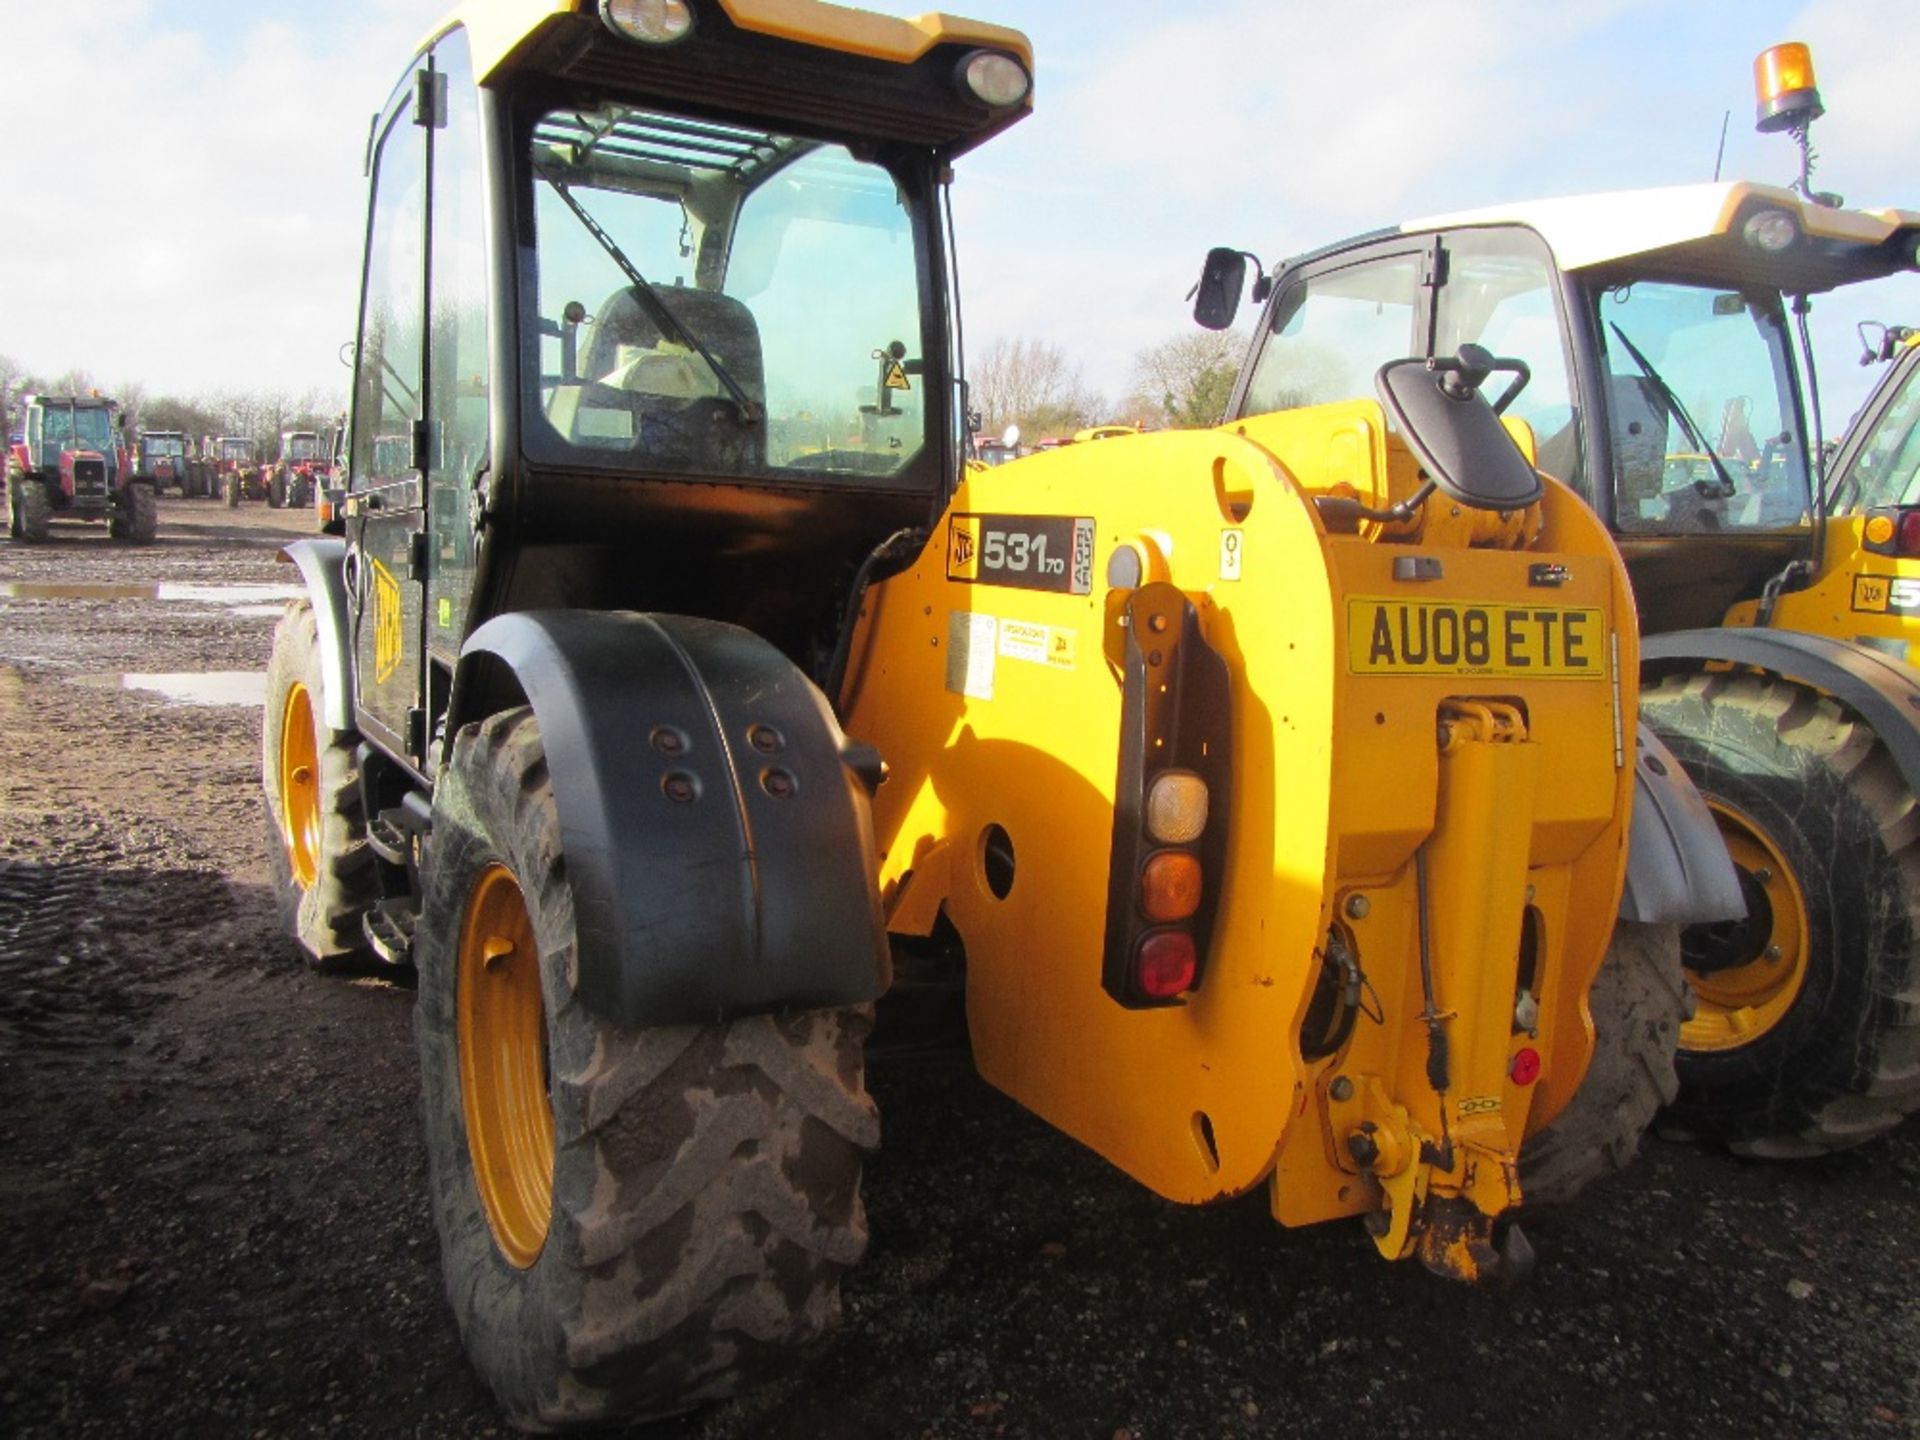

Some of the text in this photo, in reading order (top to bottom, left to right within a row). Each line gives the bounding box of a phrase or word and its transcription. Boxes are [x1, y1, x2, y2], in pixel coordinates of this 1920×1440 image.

[984, 531, 1065, 574] 531 70
[1369, 606, 1588, 667] AU08 ETE
